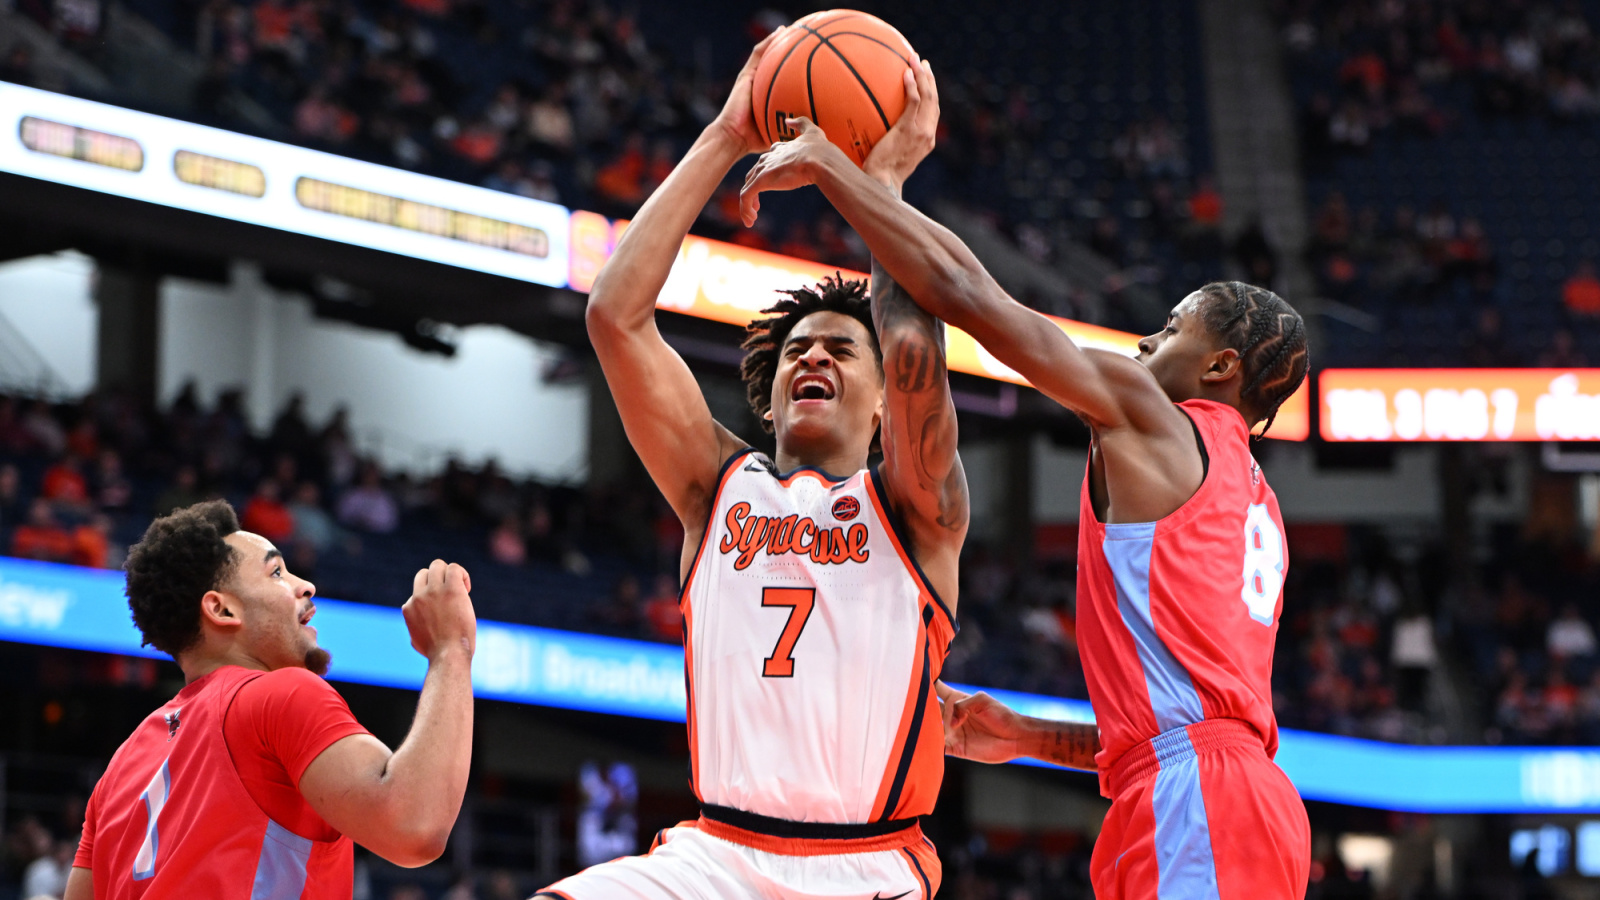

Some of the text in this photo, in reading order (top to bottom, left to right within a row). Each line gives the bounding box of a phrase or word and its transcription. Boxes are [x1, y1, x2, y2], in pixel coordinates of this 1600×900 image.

[719, 501, 870, 571] Syracuse
[1241, 502, 1284, 627] 8
[761, 586, 816, 677] 7
